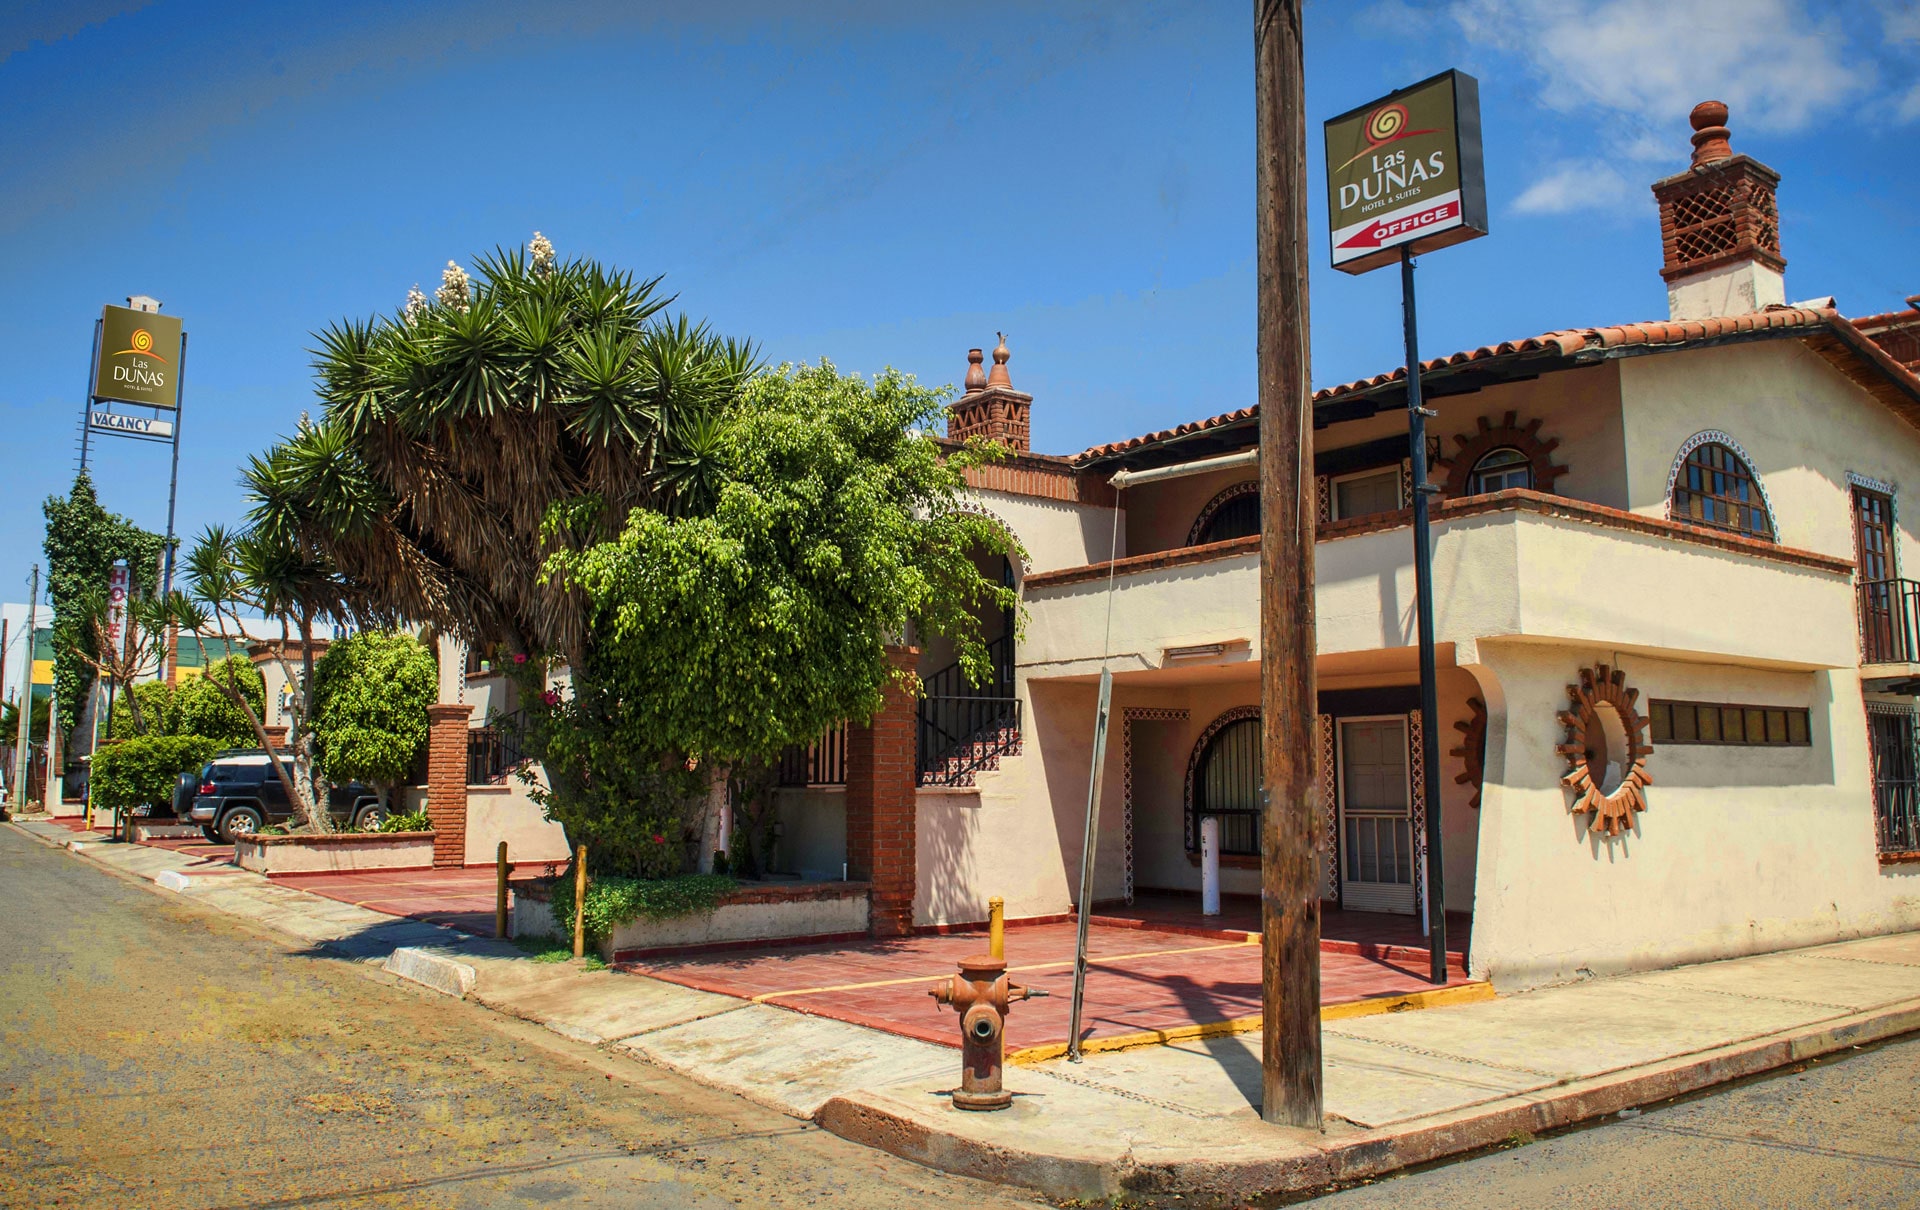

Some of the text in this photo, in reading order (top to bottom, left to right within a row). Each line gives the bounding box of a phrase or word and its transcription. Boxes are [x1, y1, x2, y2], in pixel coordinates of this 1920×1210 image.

[1371, 150, 1405, 174] Las
[1339, 151, 1445, 210] DUNAS
[1361, 186, 1421, 213] HOTEL & SUITES
[1372, 207, 1449, 239] OFFICE
[132, 357, 148, 369] Las
[113, 365, 164, 387] DUNAS
[94, 413, 151, 431] VACANCY
[107, 569, 127, 657] HOTE
